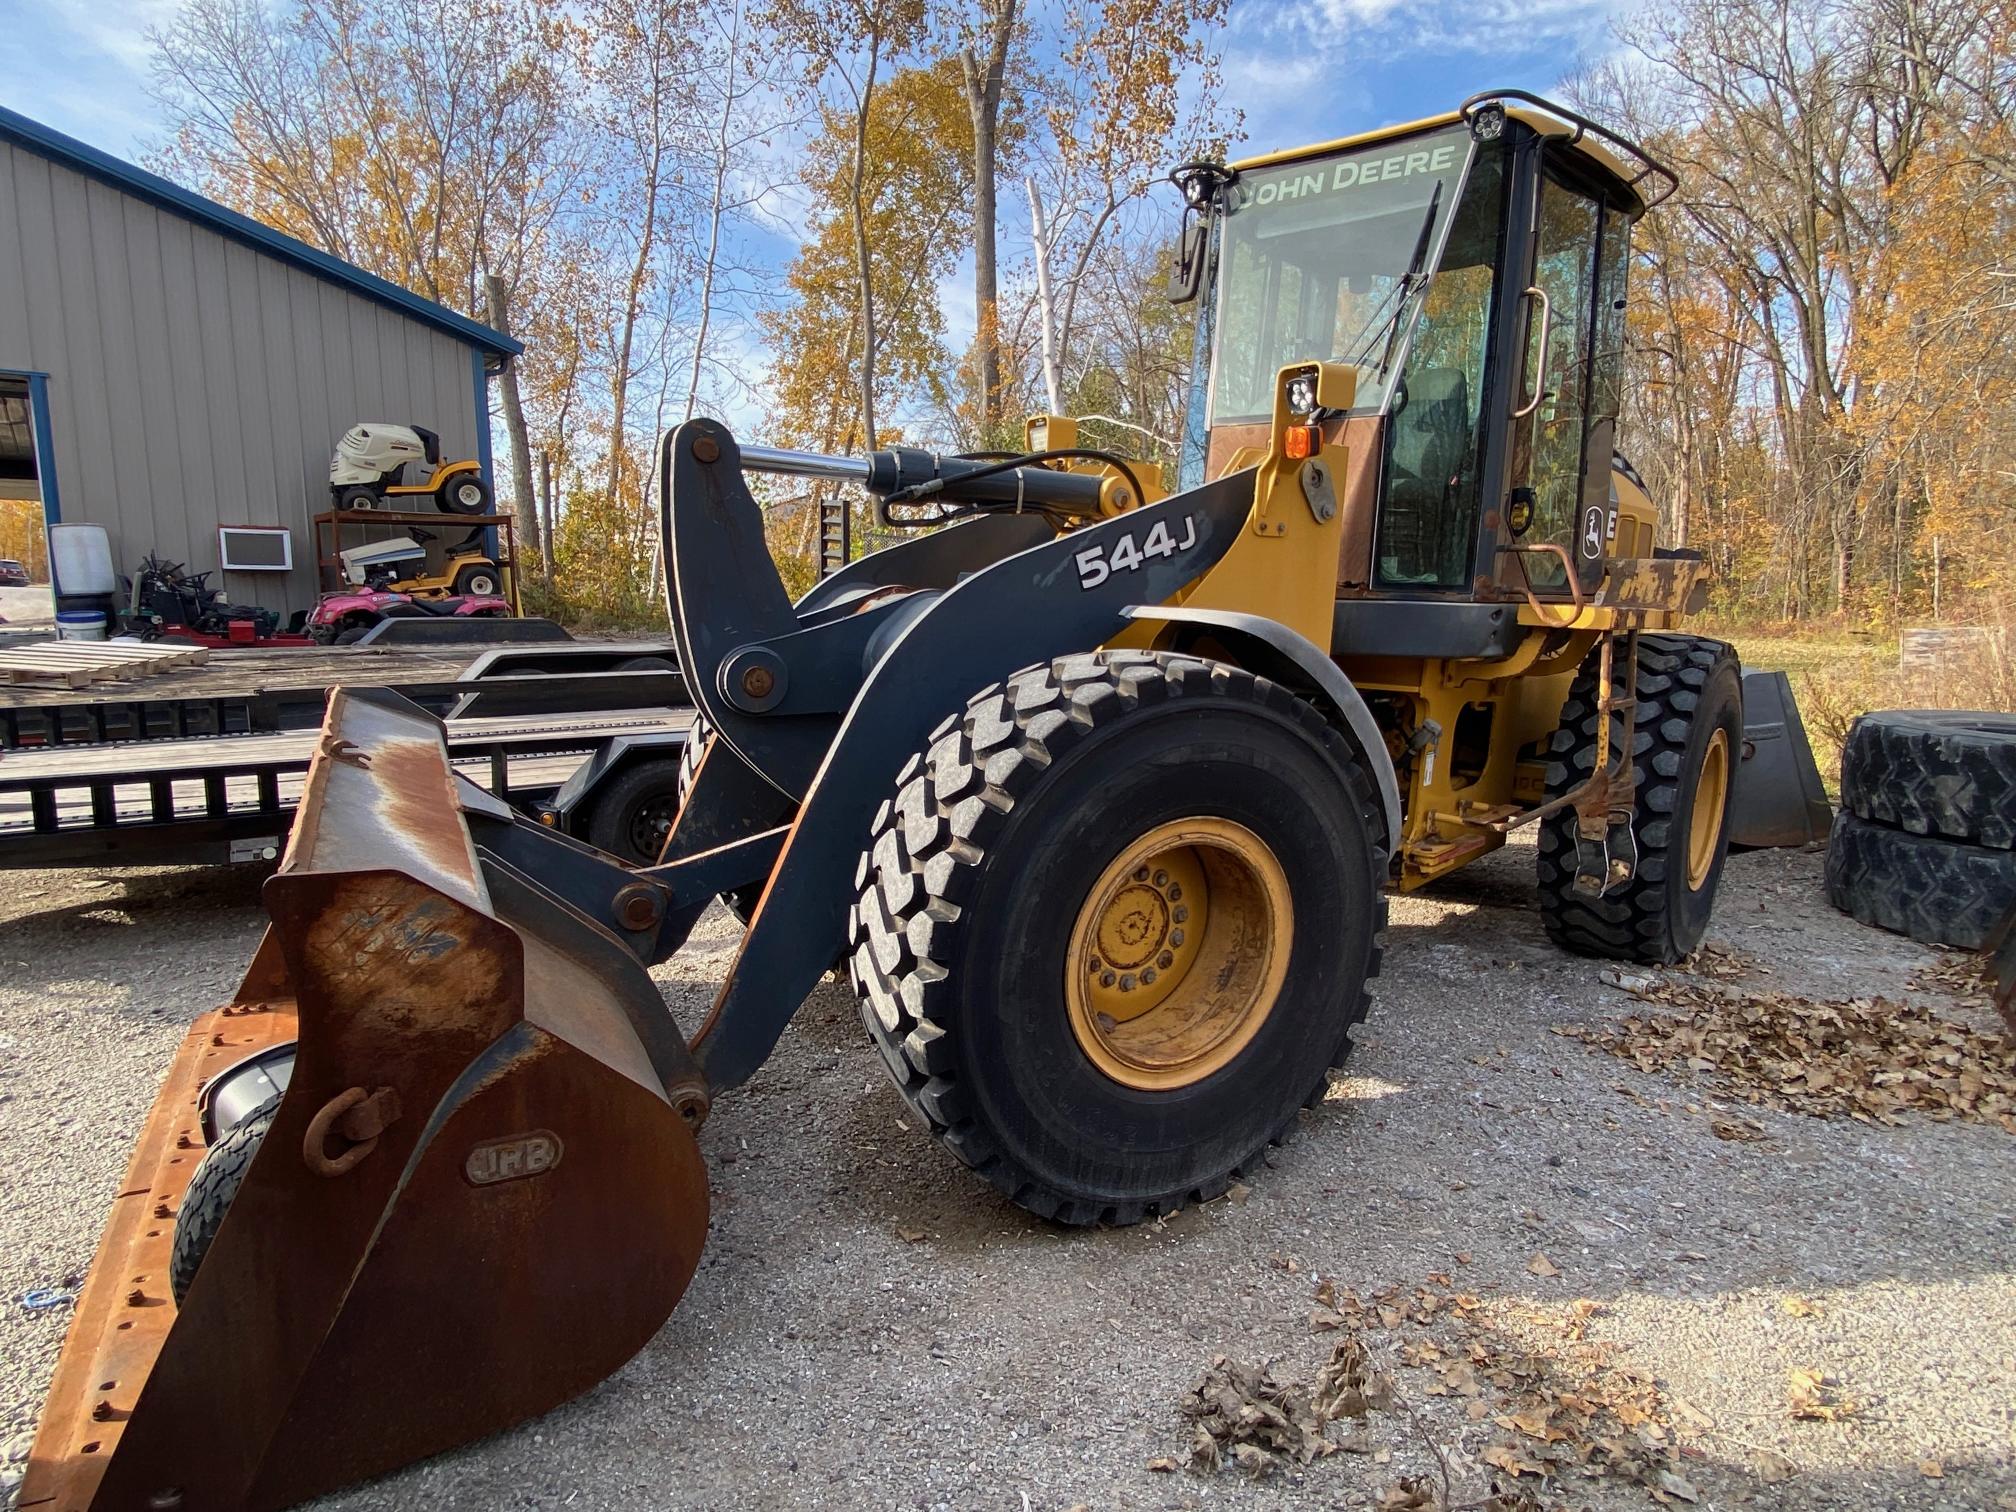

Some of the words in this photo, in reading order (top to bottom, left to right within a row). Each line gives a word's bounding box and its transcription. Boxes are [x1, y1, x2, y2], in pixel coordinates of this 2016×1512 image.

[1240, 172, 1324, 209] JOHN
[1332, 146, 1455, 191] DEERE
[1076, 516, 1196, 589] 544J
